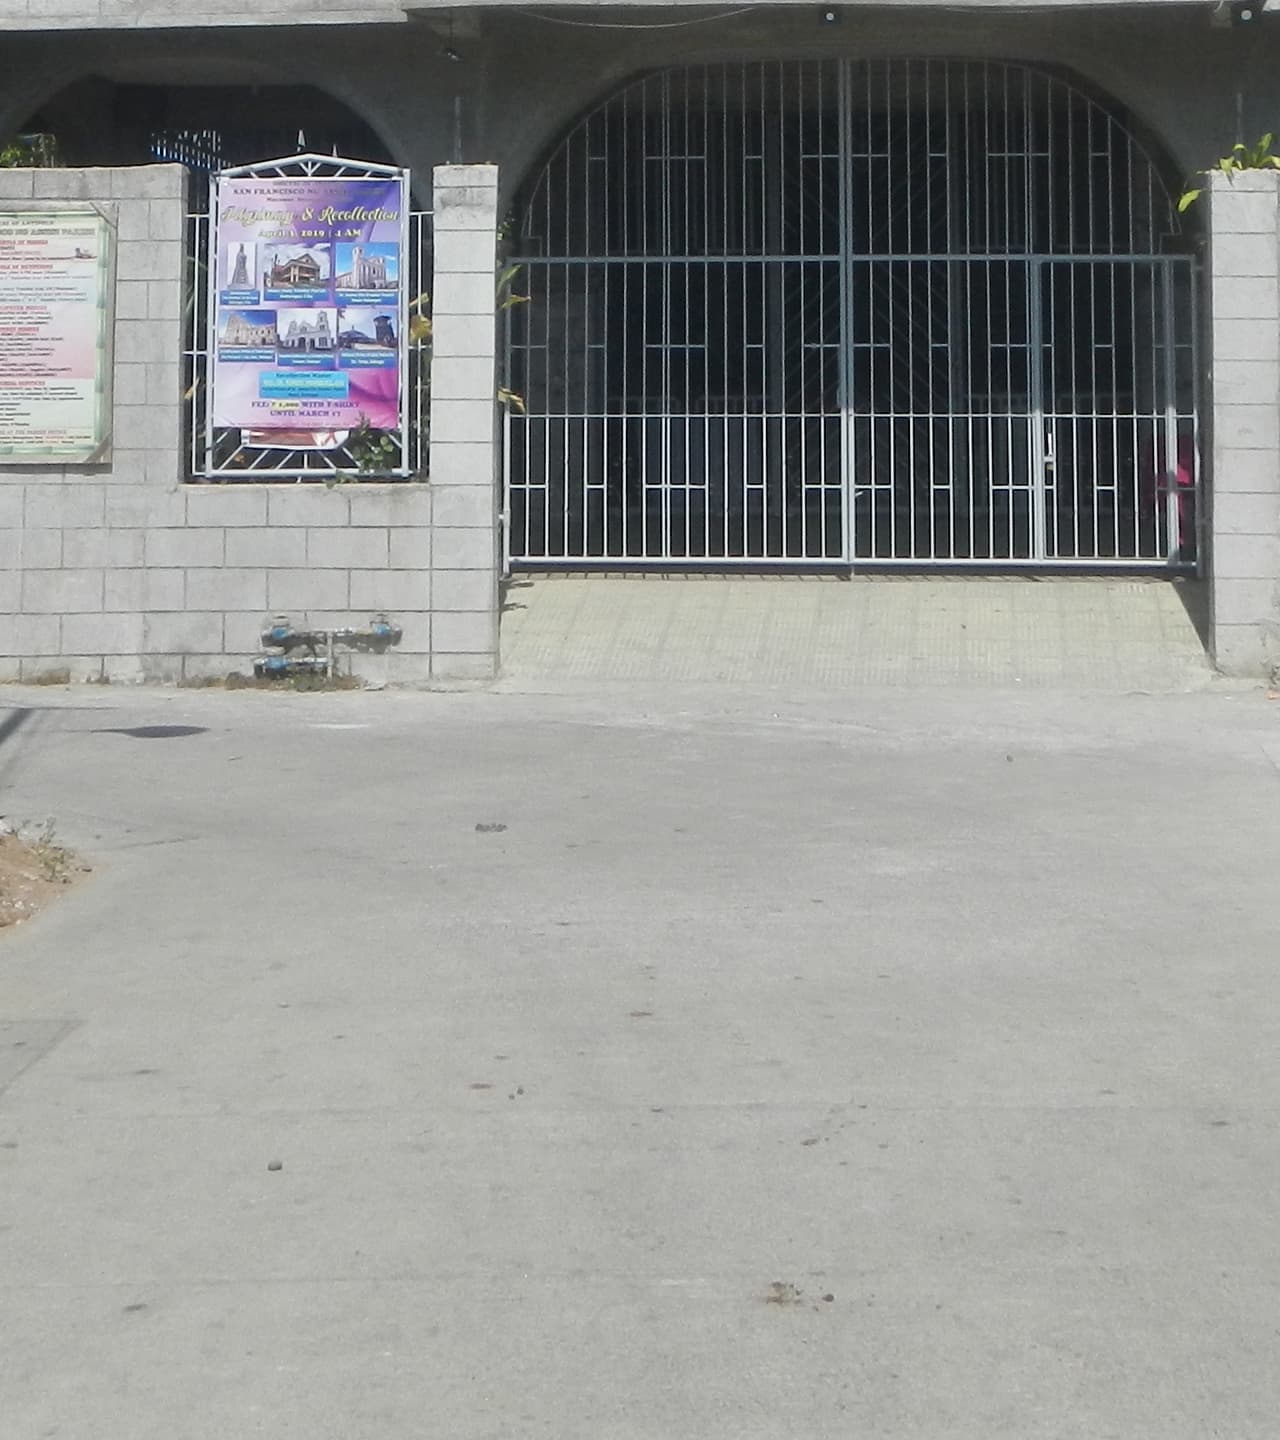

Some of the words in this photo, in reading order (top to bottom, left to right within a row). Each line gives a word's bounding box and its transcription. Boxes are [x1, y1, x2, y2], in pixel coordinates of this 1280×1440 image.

[300, 207, 313, 222] &
[317, 206, 399, 227] Recollection
[300, 230, 325, 238] 2019
[345, 228, 361, 237] AM
